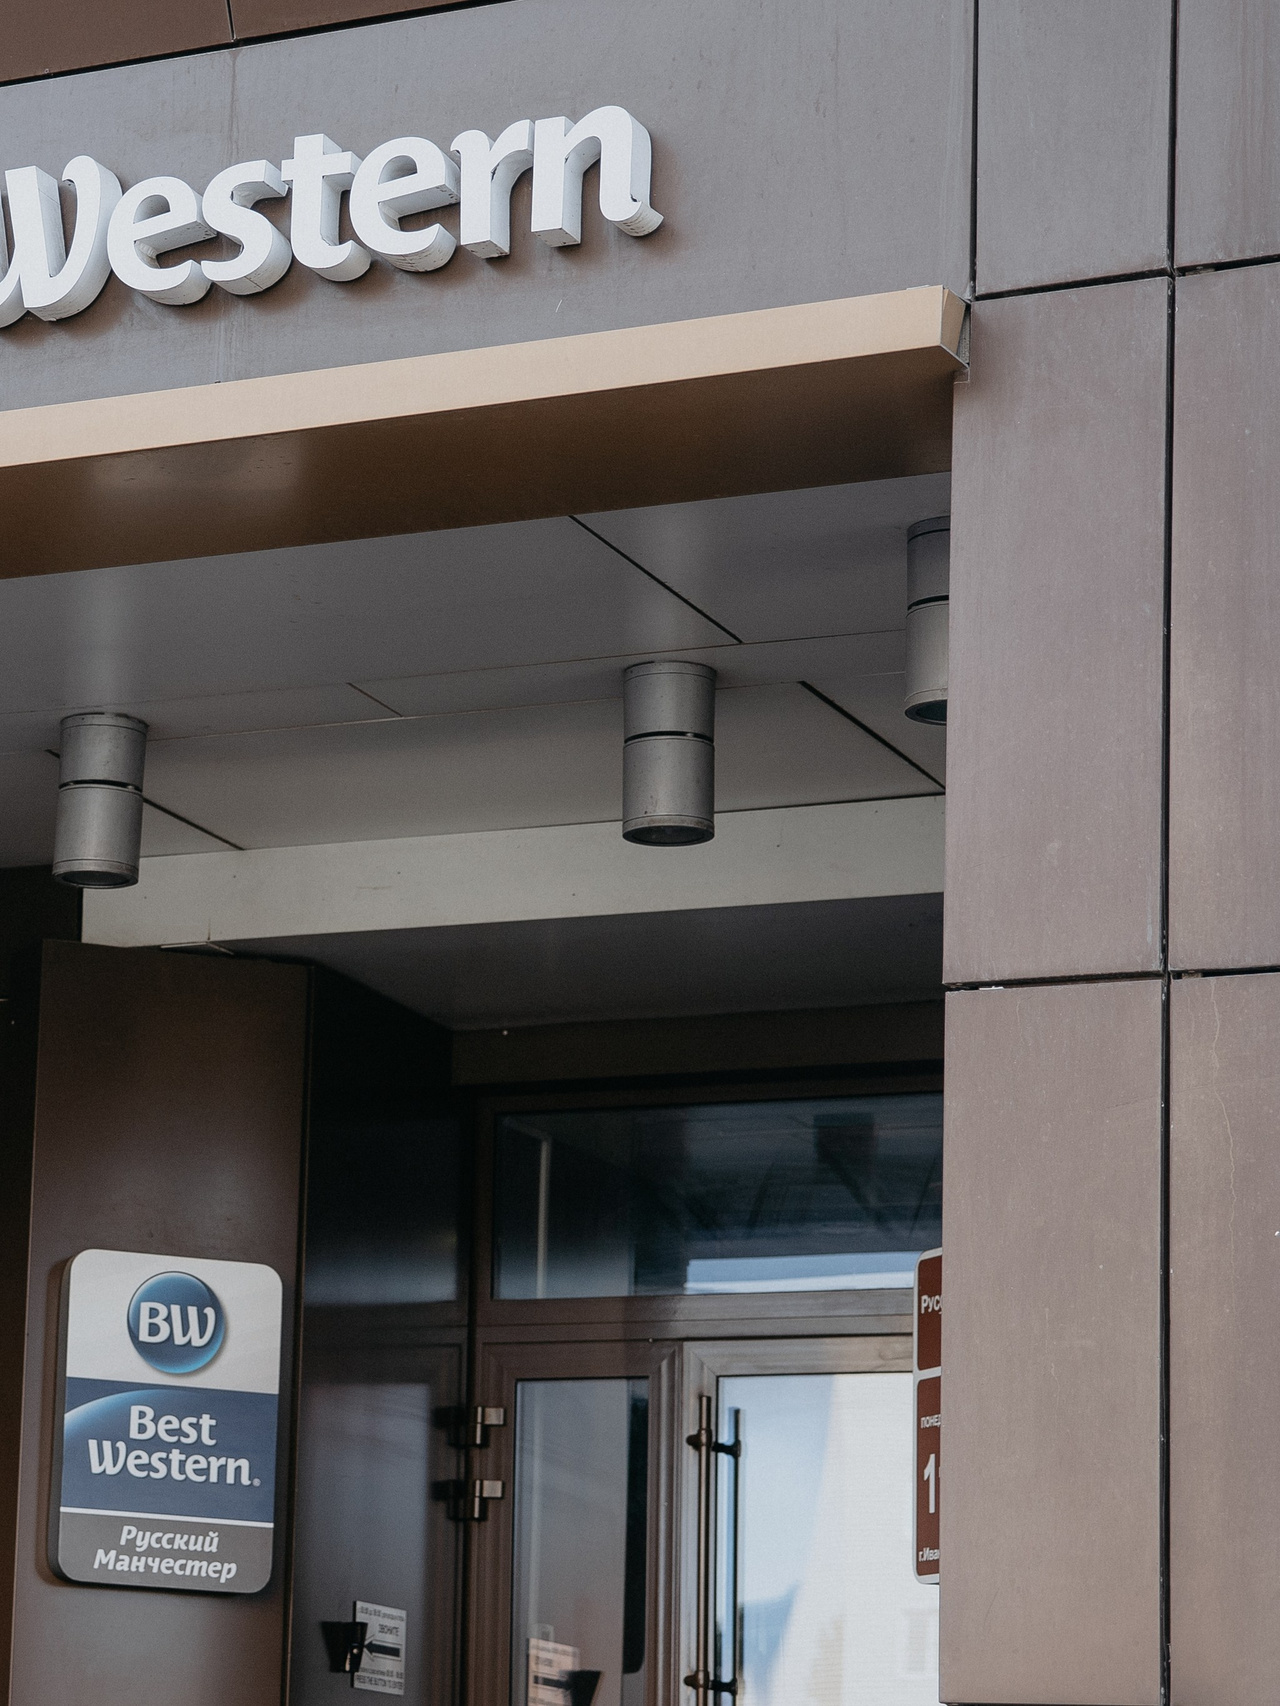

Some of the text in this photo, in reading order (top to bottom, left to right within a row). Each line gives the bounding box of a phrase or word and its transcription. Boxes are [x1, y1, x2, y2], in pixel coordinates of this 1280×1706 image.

[138, 1301, 216, 1347] BW
[129, 1404, 218, 1447] Best
[120, 1525, 220, 1553] Русский
[93, 1549, 238, 1584] Манчестер
